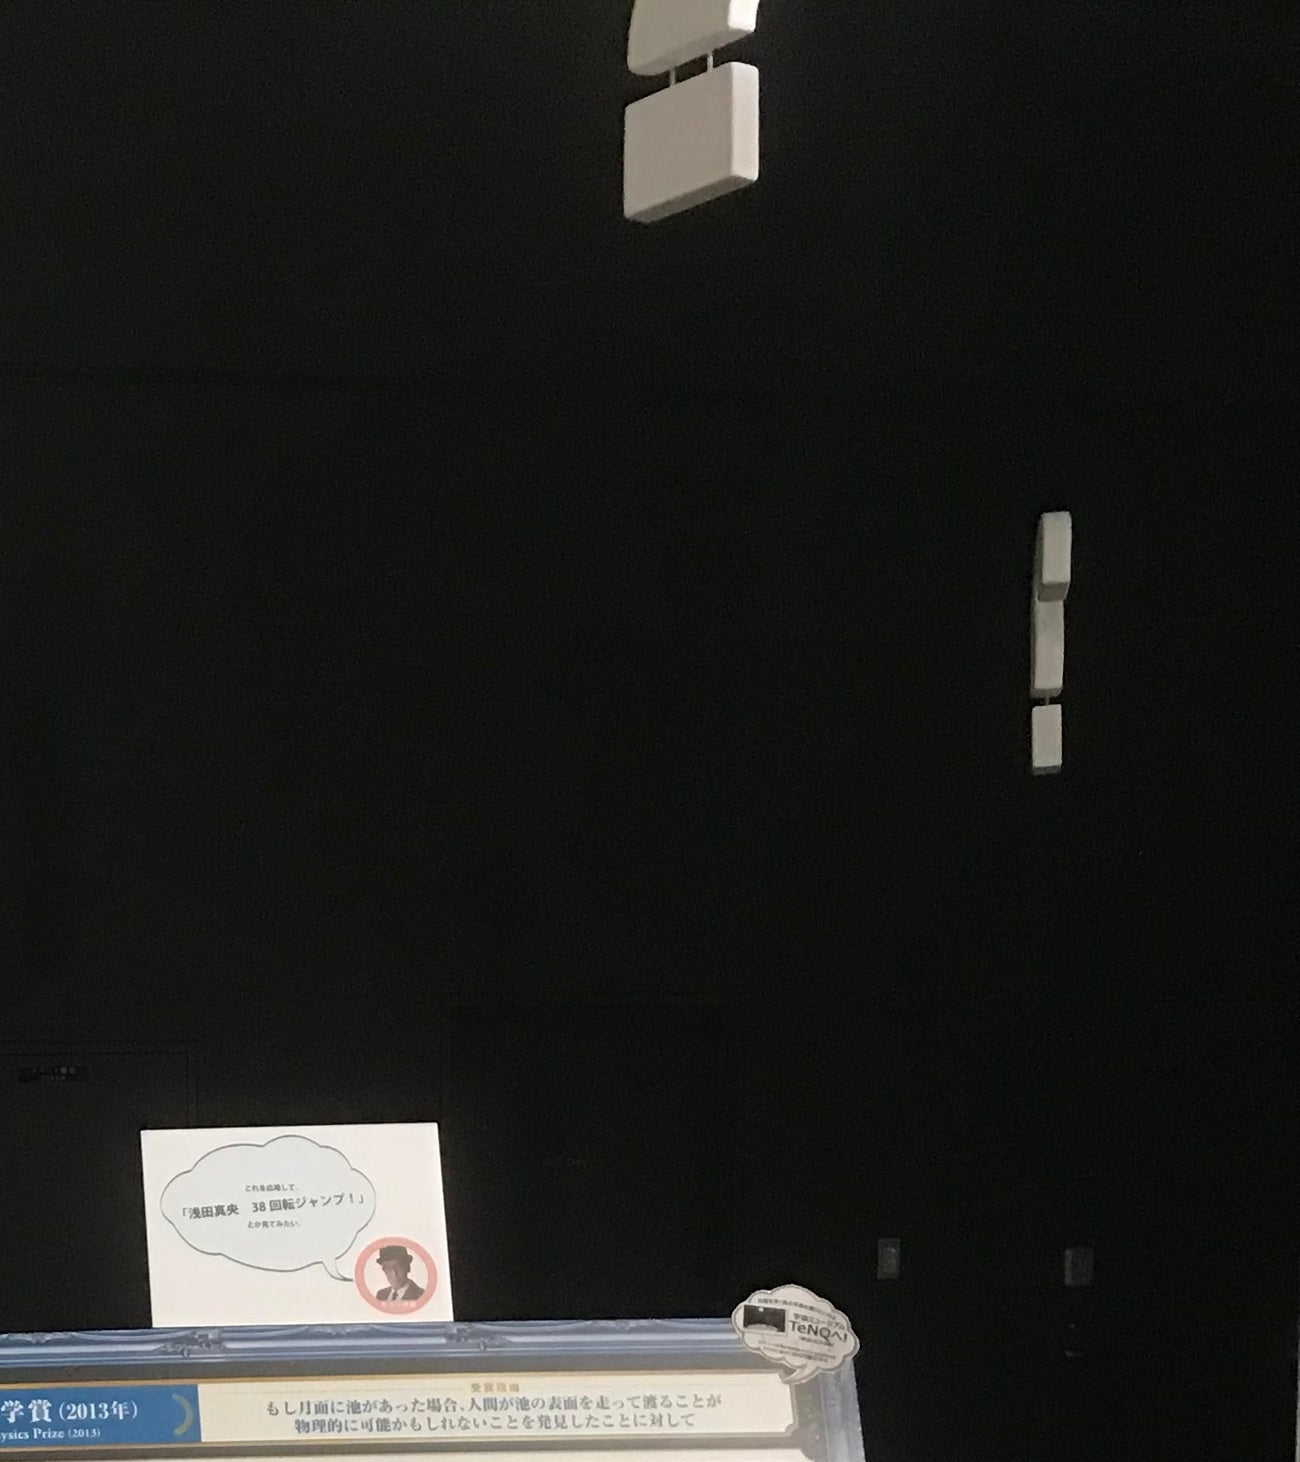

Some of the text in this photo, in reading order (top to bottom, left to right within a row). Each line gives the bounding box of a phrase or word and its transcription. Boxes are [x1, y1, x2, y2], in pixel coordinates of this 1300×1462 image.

[267, 1393, 721, 1417] もし月面に池があった場合、人間が池の表面を走って渡ることが
[294, 1411, 695, 1433] 物理的に可能かもしれないことを発見したことに対して
[33, 1428, 64, 1439] Prize
[68, 1428, 100, 1438] (2013)
